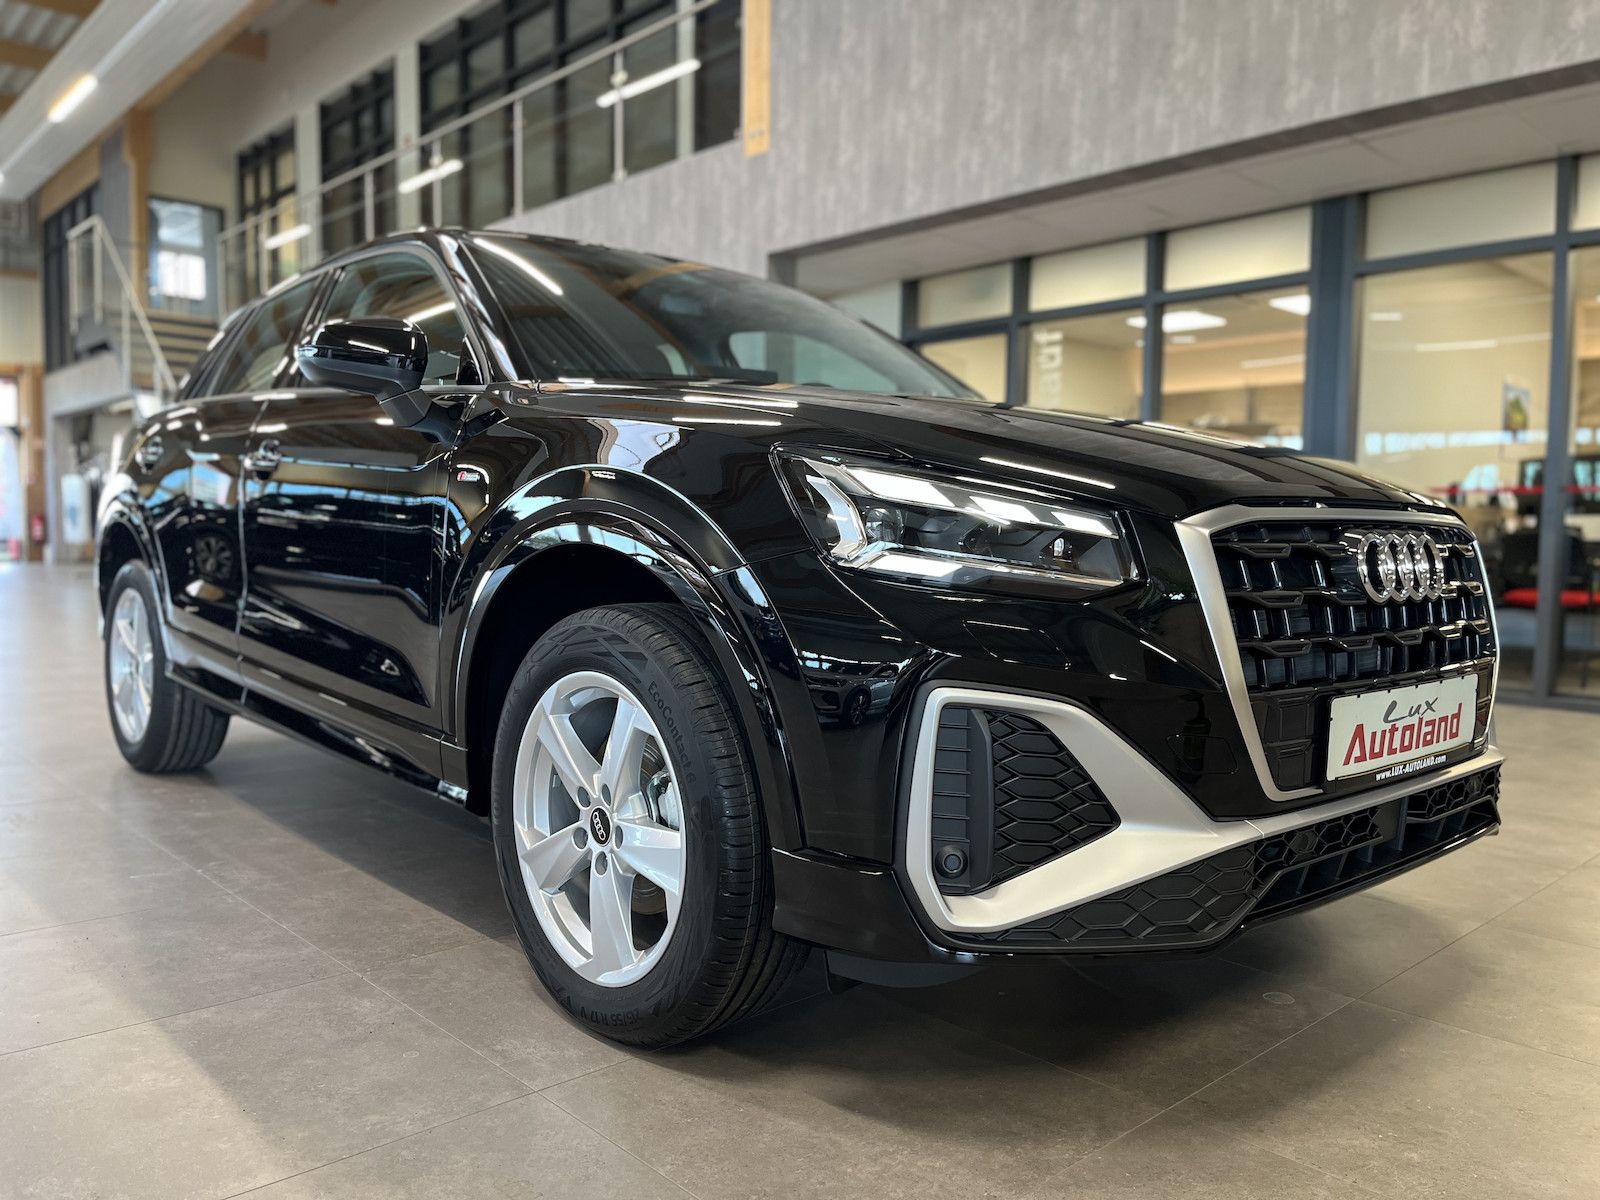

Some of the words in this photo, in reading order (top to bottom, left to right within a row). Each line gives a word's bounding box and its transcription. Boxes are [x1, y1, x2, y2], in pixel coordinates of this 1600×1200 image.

[648, 681, 691, 768] EcoContact
[1383, 697, 1438, 723] Lux
[1342, 703, 1463, 766] Autoland
[1375, 755, 1447, 781] www.LUX-AUTOLAND.com
